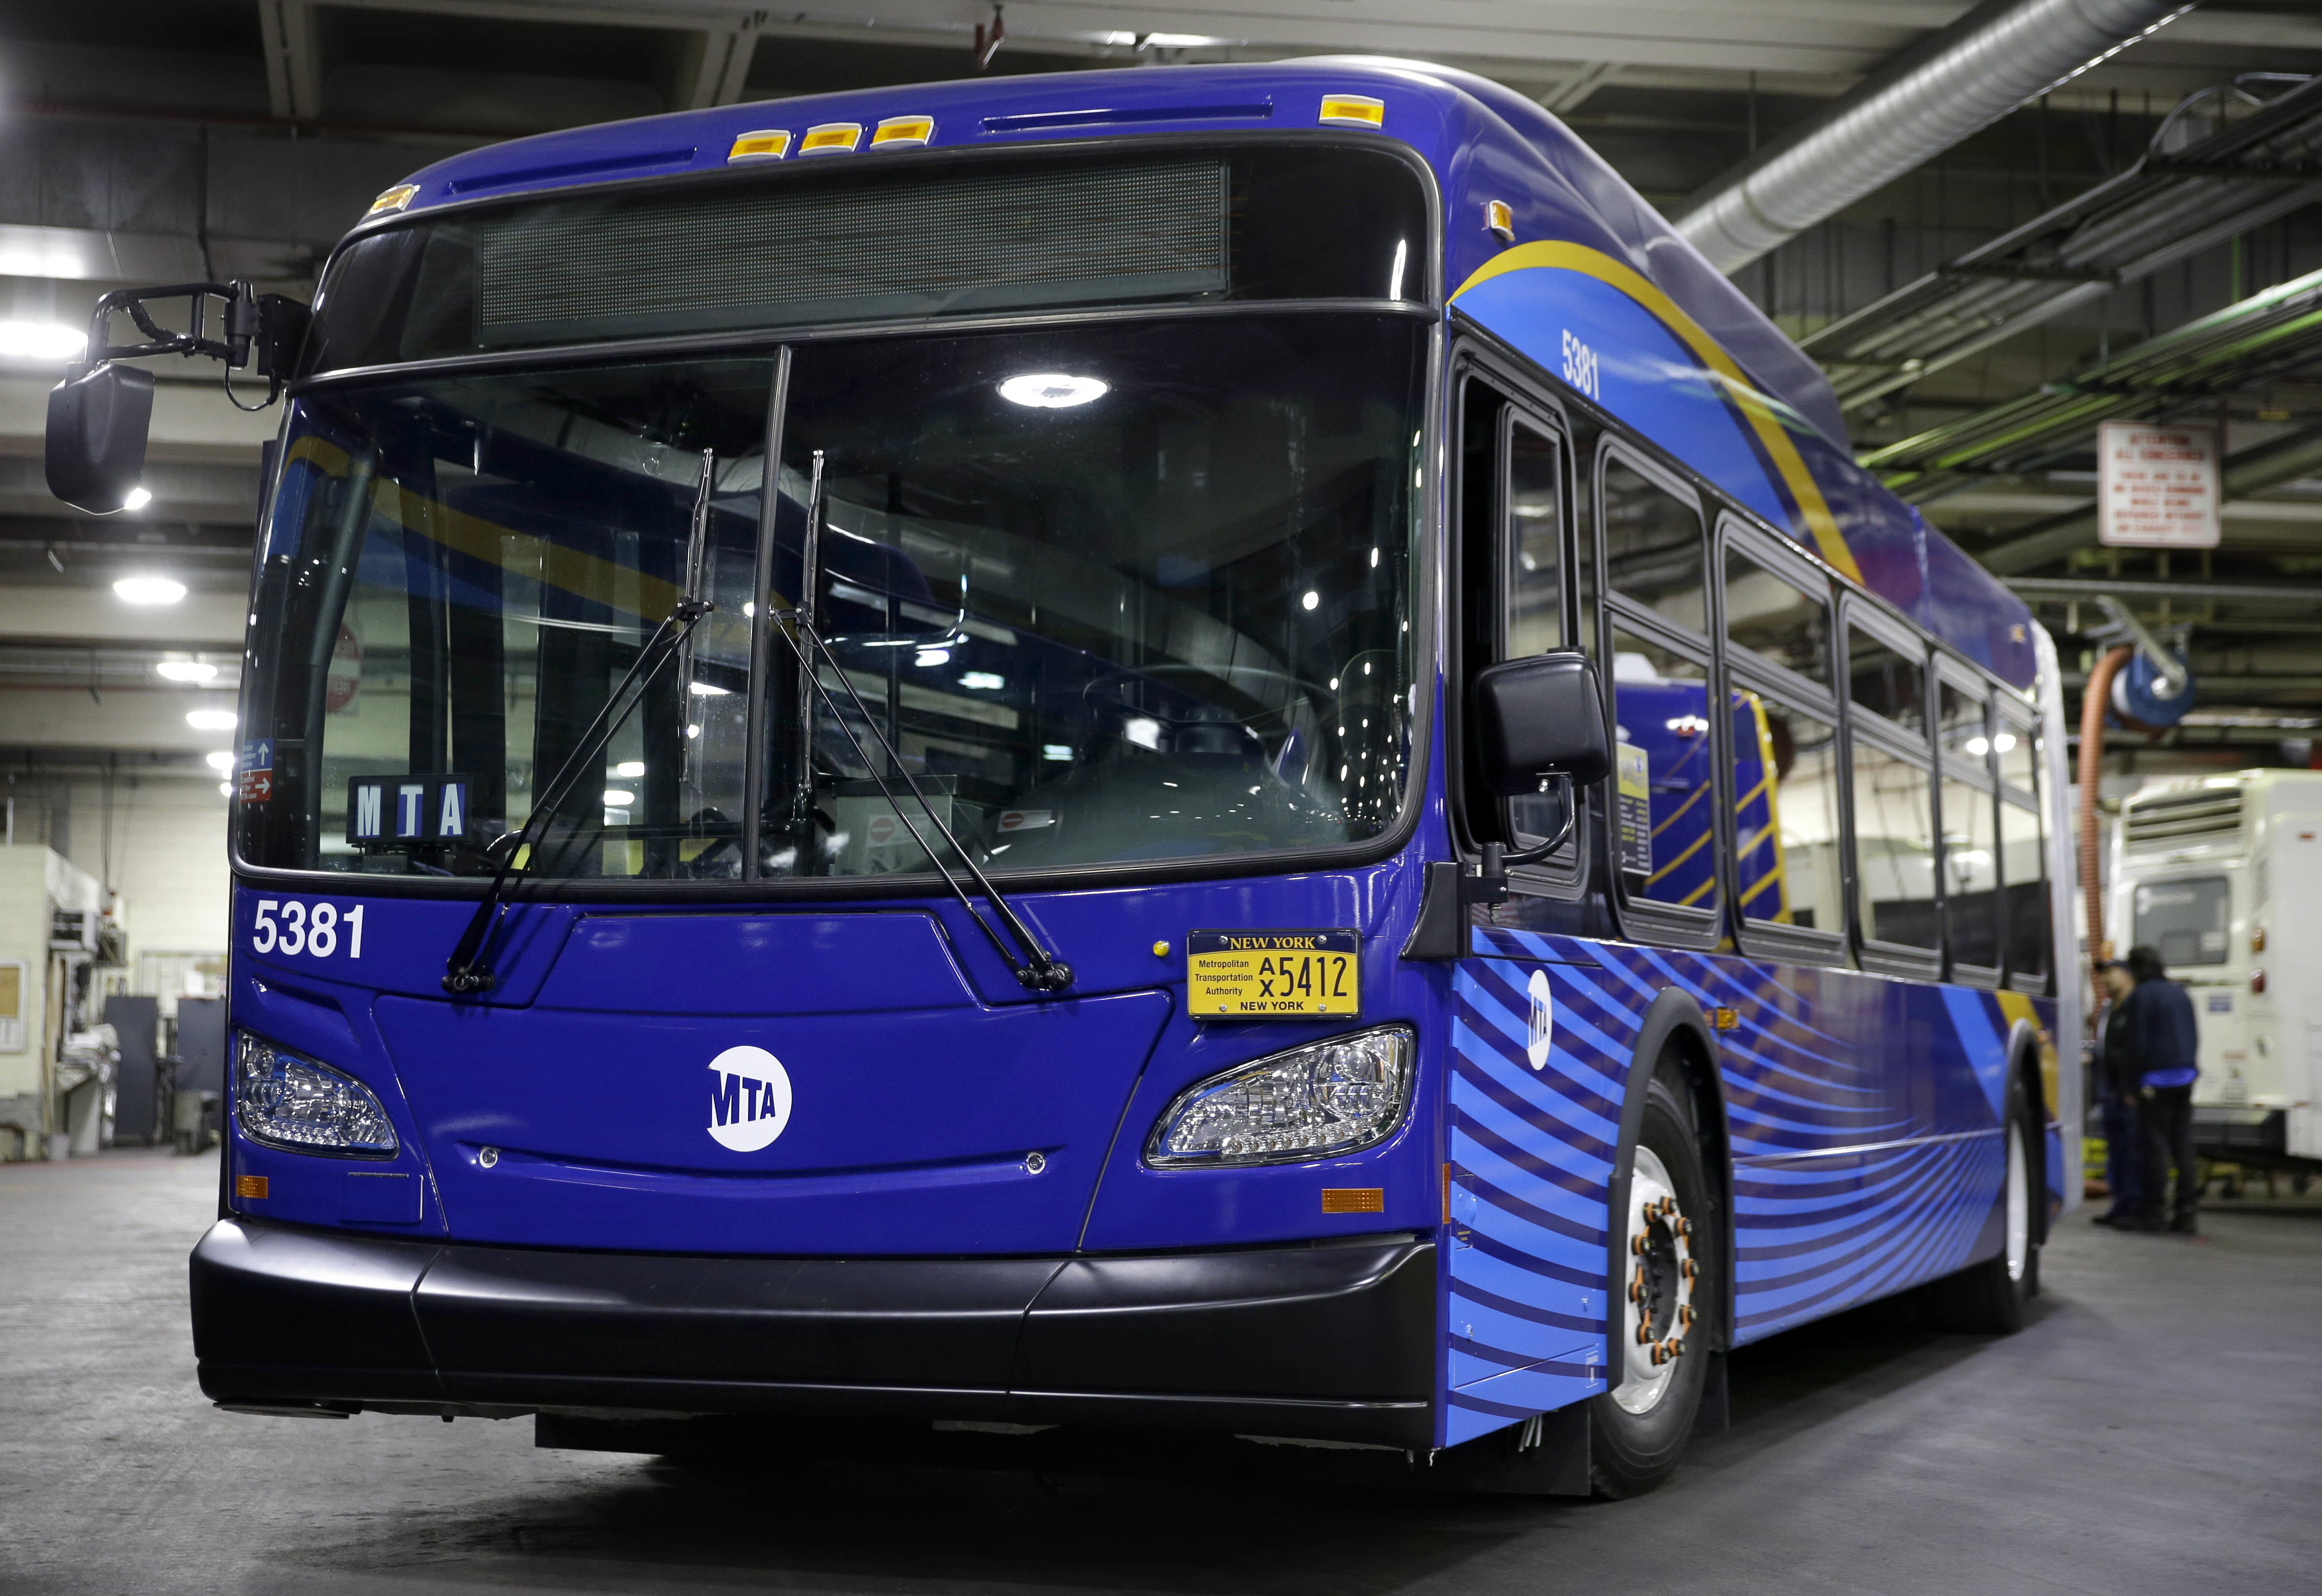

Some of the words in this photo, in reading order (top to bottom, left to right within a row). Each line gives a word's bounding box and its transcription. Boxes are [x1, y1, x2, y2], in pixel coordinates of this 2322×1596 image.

[1562, 328, 1600, 400] 5381
[252, 899, 364, 958] 5381
[1230, 937, 1268, 949] NEW
[1273, 937, 1316, 949] YORK
[1199, 959, 1249, 969] Metropolitan
[1195, 973, 1253, 983] Transportation
[1206, 987, 1243, 997] Authority
[1240, 1001, 1268, 1011] NEW
[1271, 1001, 1304, 1011] YORK
[704, 1067, 776, 1128] MTA
